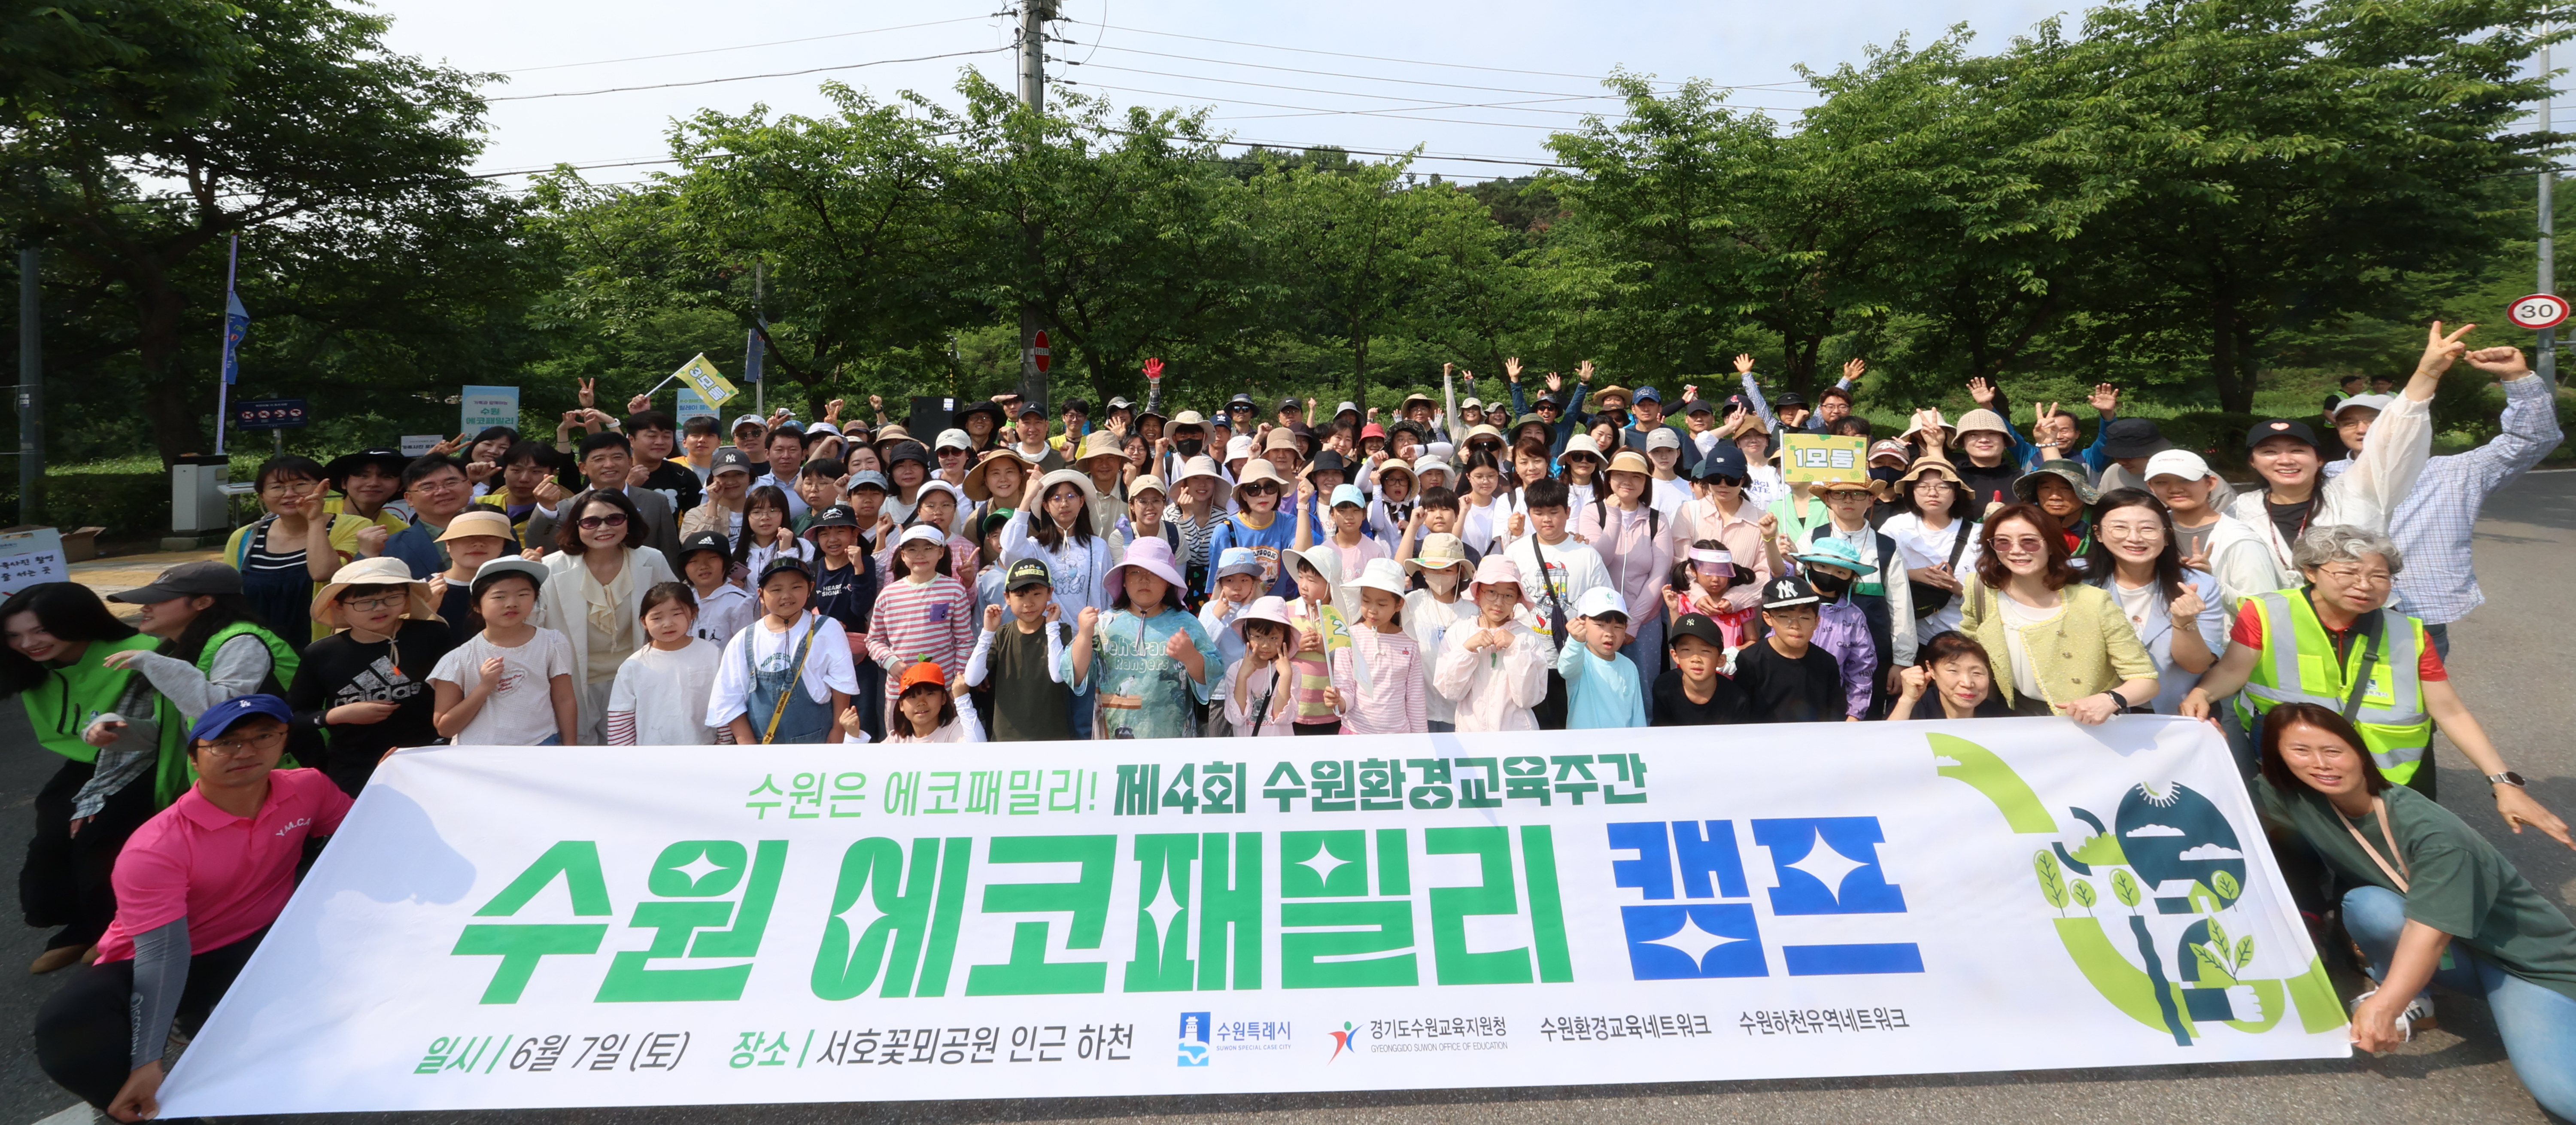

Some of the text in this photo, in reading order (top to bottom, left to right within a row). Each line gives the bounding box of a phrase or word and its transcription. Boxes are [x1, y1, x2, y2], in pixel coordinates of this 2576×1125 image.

[2521, 304, 2553, 318] 30
[689, 366, 726, 401] 3모둠
[1795, 448, 1854, 468] 1모둠
[0, 559, 30, 569] 족사진
[1015, 568, 1045, 577] YANKEES
[822, 589, 842, 597] SIGNAL
[1776, 580, 1798, 599] NY
[1101, 637, 1169, 657] Teheran
[1115, 656, 1169, 673] Rangers
[240, 699, 251, 708] LA
[746, 753, 1647, 819] 수원은 에코패밀리! 제4회 수원환경교육주간
[450, 816, 1925, 1004] 수원 에코패밀리 캠프
[1370, 1016, 1507, 1039] 경기도수원교육지원청
[1541, 1013, 1712, 1042] 수원환경교육네트워크
[1740, 1007, 1910, 1035] 수원하천유역네트워크
[1217, 1022, 1291, 1041] 수원특례시
[413, 1031, 690, 1074] 일시 6월 7일 (토)
[729, 1023, 1133, 1068] 장소 서호꽃뫼공원 인근 하천
[1371, 1041, 1508, 1052] GYEONGGIDO SUWON OFFICE OF EDUCATION
